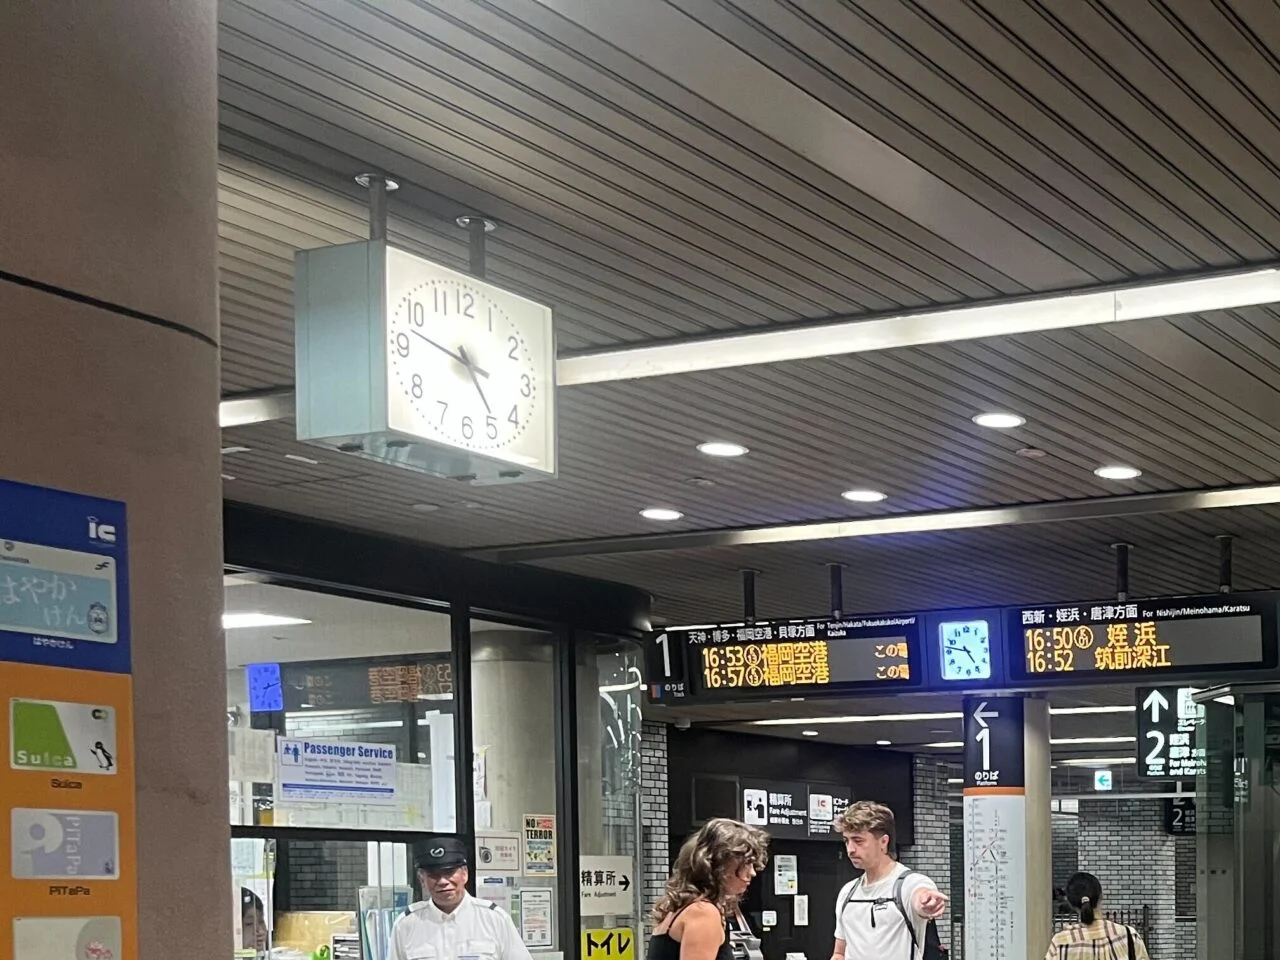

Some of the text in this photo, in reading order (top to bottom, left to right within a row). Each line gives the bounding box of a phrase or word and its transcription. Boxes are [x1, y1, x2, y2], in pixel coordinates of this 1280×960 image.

[408, 298, 424, 327] 10
[434, 287, 447, 316] 11
[456, 288, 475, 319] 12
[396, 332, 409, 358] 9
[507, 336, 519, 361] 2
[411, 373, 423, 399] 8
[520, 374, 531, 397] 3
[436, 400, 448, 425] 7
[507, 404, 519, 429] 4
[461, 416, 473, 440] 6
[486, 415, 498, 440] 5
[1142, 610, 1154, 618] For
[1025, 627, 1073, 651] 16:50
[655, 633, 671, 677] 1
[702, 645, 745, 668] 16:53
[761, 640, 829, 666] 福岡空港
[1026, 645, 1172, 673] 16:52 筑前深江
[664, 683, 685, 692] のりば
[704, 666, 745, 688] 16:57
[763, 662, 831, 687] 福岡空港
[304, 741, 393, 760] Passenger Service
[975, 727, 990, 771] 1
[1145, 730, 1166, 765] 2
[974, 770, 999, 781] のりば
[526, 818, 536, 829] NO
[1172, 808, 1184, 826] 2
[526, 829, 553, 840] TERROR
[581, 870, 617, 888] 精算所
[587, 932, 631, 957] トイレ
